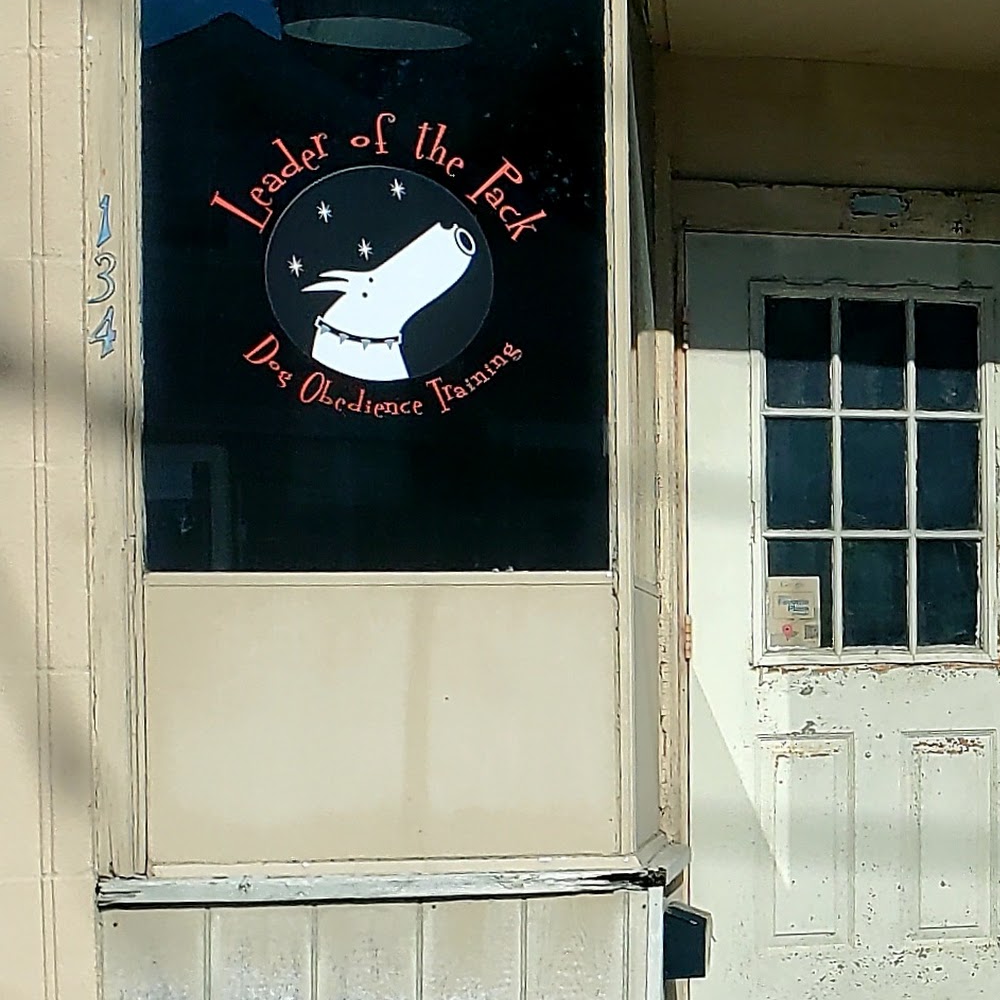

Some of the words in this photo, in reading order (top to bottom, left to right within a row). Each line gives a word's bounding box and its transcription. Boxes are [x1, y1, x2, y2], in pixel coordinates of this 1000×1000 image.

[210, 132, 329, 234] Leader
[350, 112, 396, 155] of
[414, 121, 465, 178] the
[465, 156, 547, 242] Pack
[86, 194, 117, 359] 134
[243, 333, 294, 388] Dog
[300, 371, 423, 418] Obedience
[425, 341, 523, 414] Training
